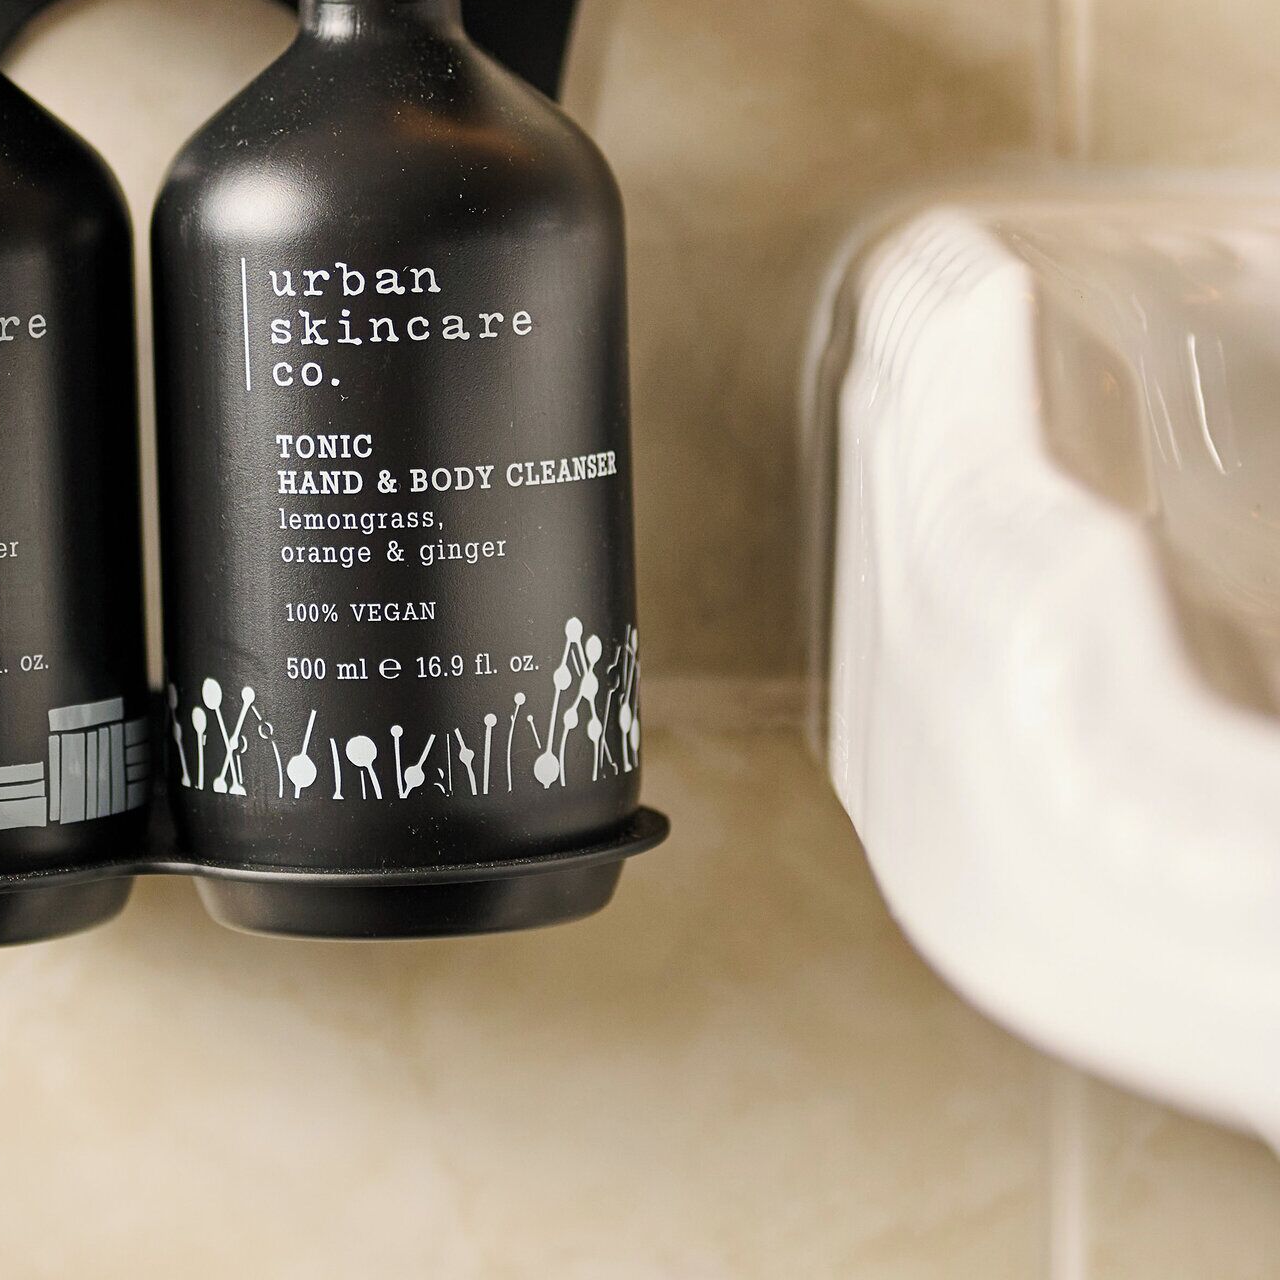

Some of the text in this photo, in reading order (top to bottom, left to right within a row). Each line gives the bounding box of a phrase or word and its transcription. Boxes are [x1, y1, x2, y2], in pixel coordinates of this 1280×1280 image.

[270, 261, 441, 297] urban
[267, 308, 533, 346] skincare
[272, 361, 340, 387] co.
[275, 433, 373, 459] TONIC
[276, 451, 617, 495] HAND & BODY CLEANSER
[278, 507, 443, 535] lemongrass,
[280, 539, 507, 569] orange & ginger
[285, 601, 437, 623] 100% VEGAN
[20, 653, 50, 673] oz.
[286, 656, 326, 680] 500
[336, 658, 369, 680] ml
[416, 654, 464, 678] 16.9
[475, 653, 498, 675] fl.
[509, 653, 540, 673] oz.
